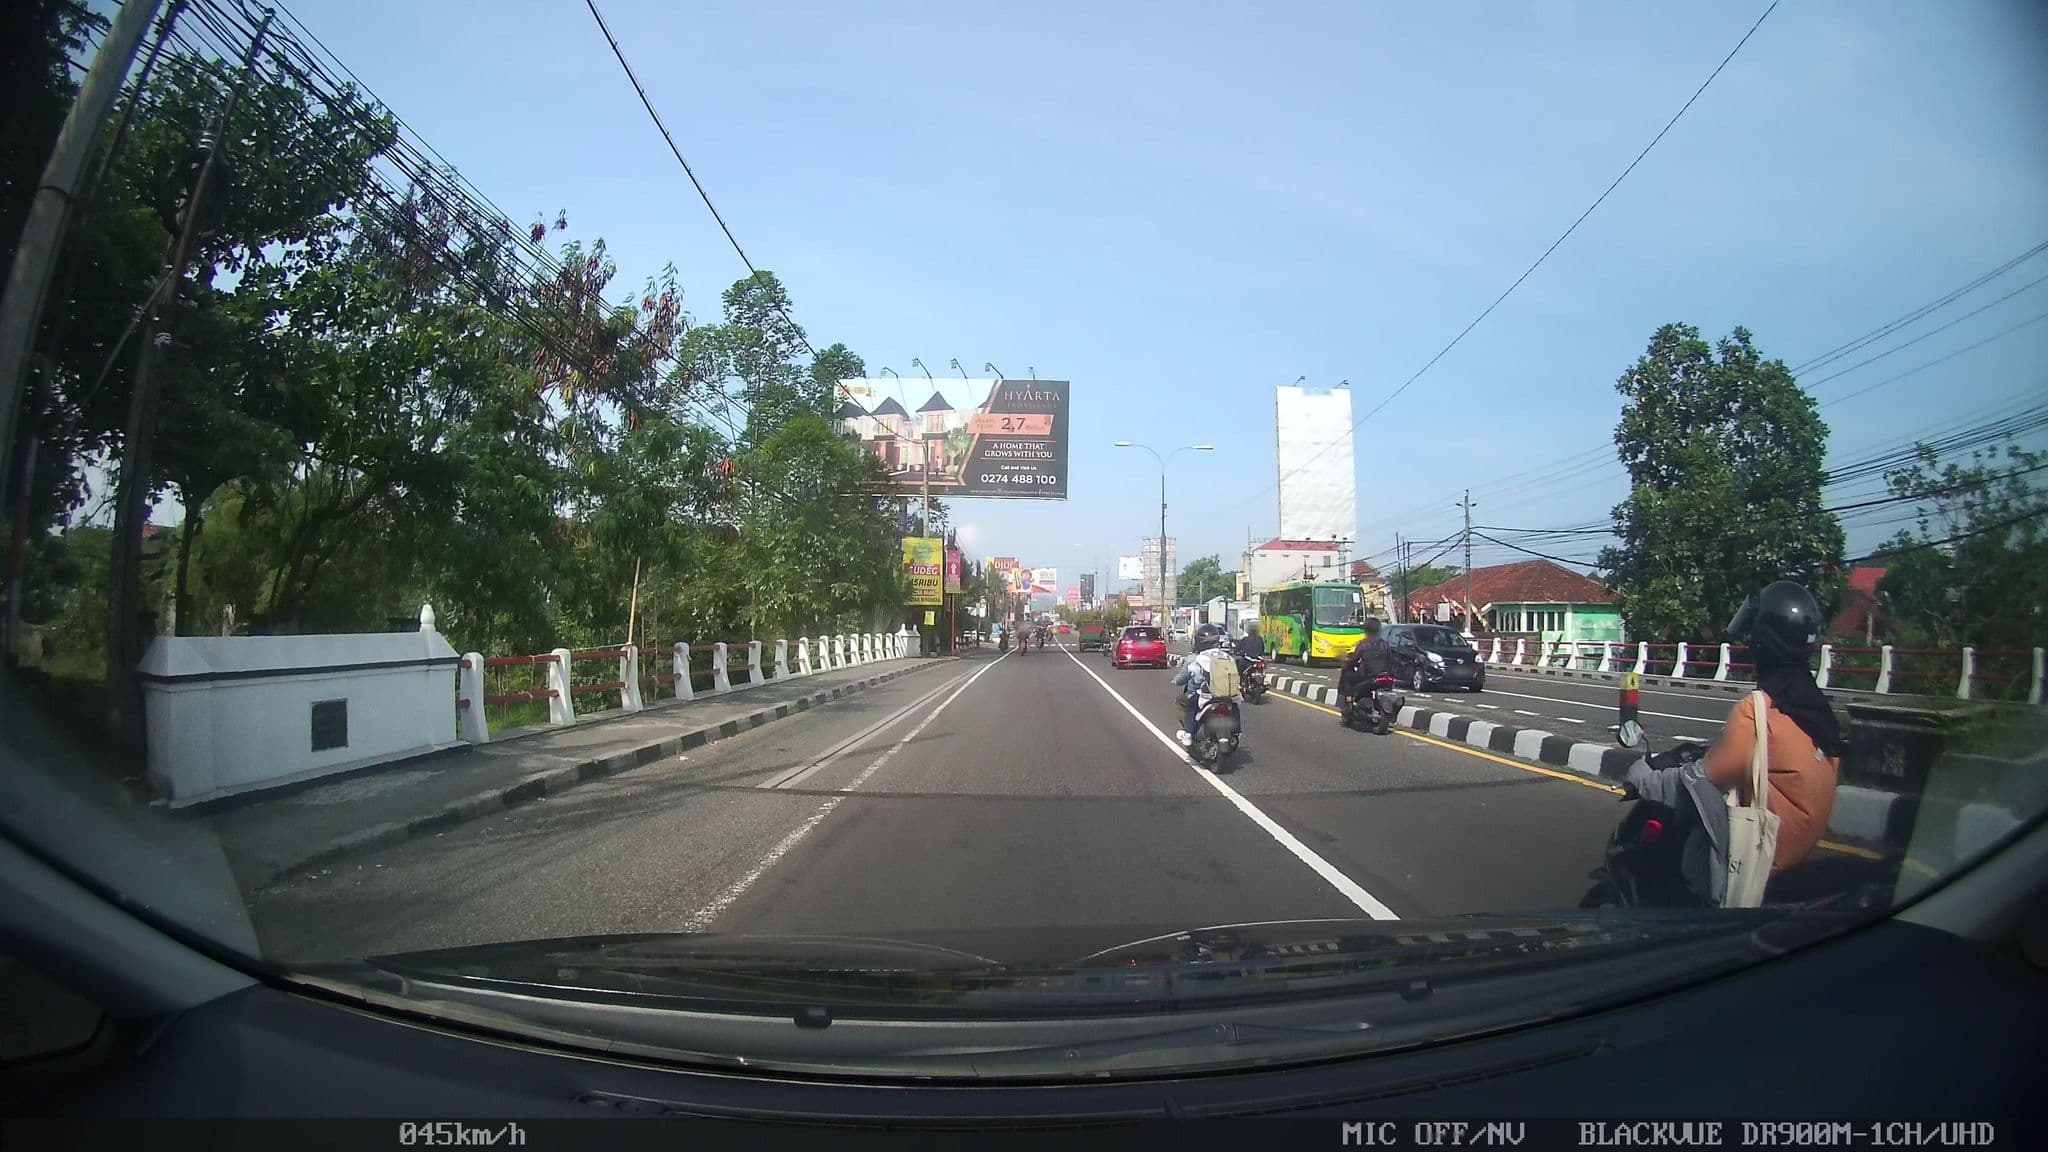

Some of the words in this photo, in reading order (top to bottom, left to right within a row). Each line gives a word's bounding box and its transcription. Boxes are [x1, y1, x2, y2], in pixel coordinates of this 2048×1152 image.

[1004, 388, 1060, 401] HYARTA
[1001, 417, 1026, 432] 2,7
[992, 442, 999, 450] A
[1000, 442, 1023, 450] HOME
[1014, 450, 1035, 458] WITH
[981, 474, 1008, 484] 0274
[1011, 474, 1033, 484] 488
[1036, 475, 1056, 485] 100
